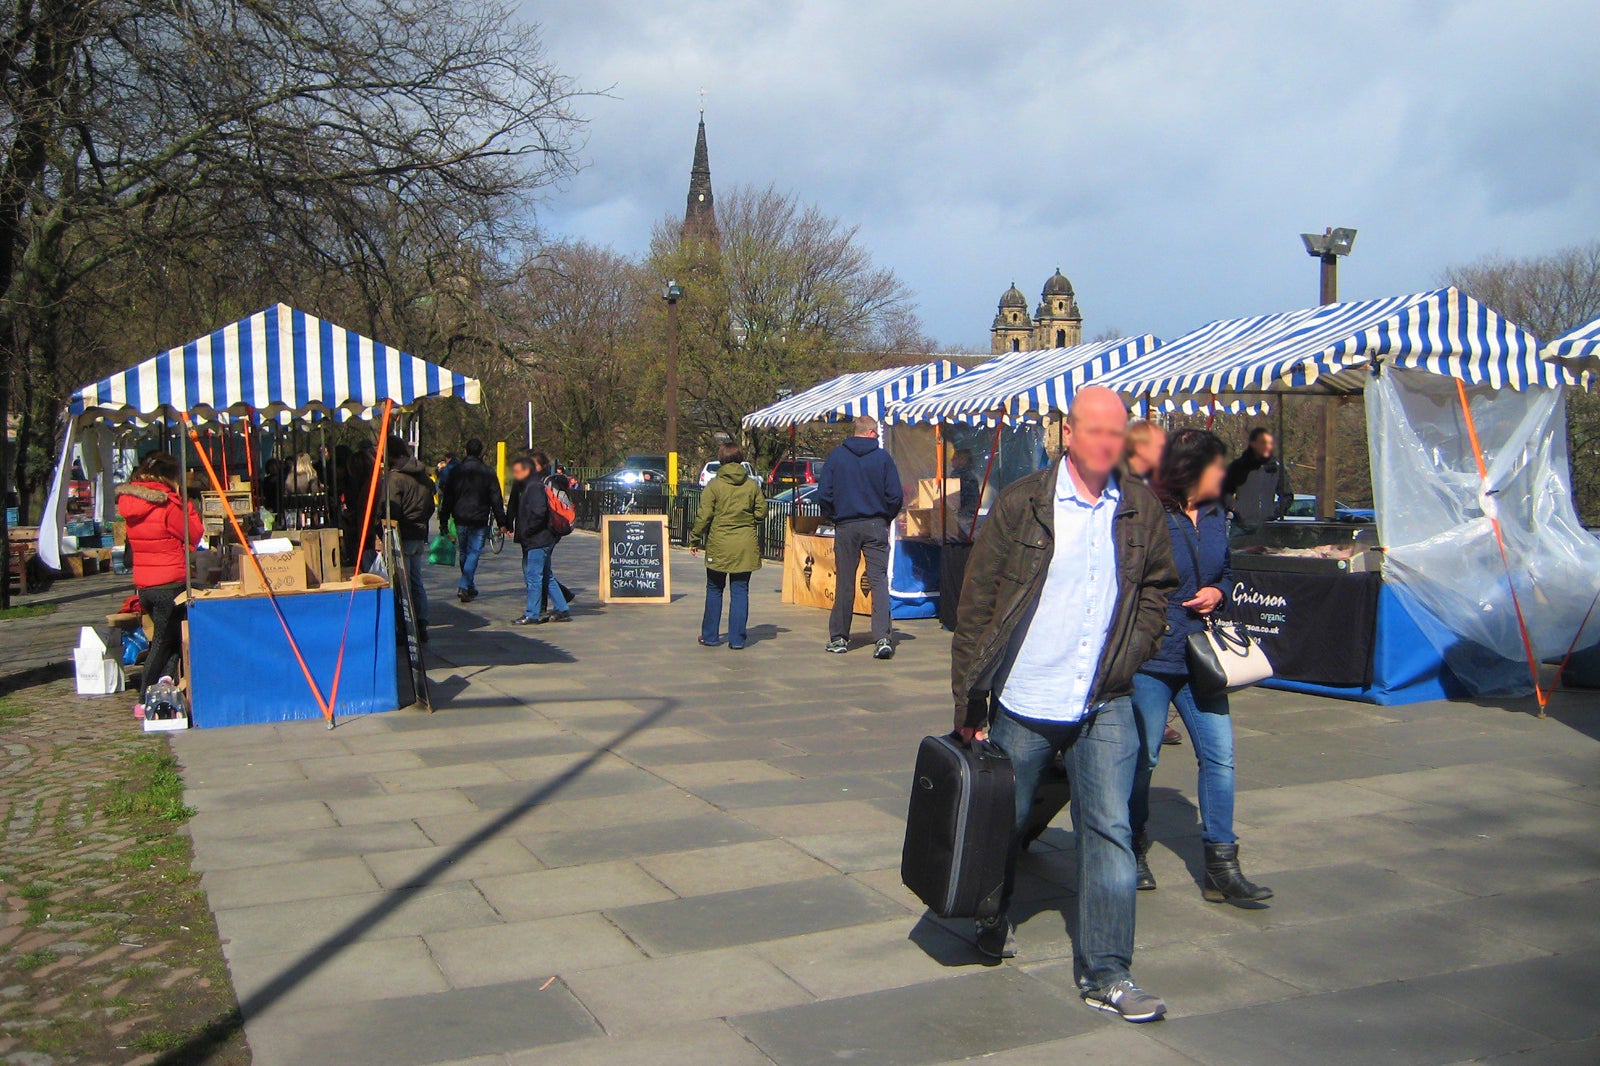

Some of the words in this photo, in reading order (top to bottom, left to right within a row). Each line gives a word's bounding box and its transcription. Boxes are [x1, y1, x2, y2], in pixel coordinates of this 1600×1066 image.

[613, 542, 635, 557] 10%
[636, 544, 658, 557] OFF
[645, 570, 661, 580] PRICE
[613, 579, 635, 589] STEAK
[636, 579, 657, 590] MINCE
[1232, 581, 1287, 608] Grierson
[1260, 612, 1286, 624] organic
